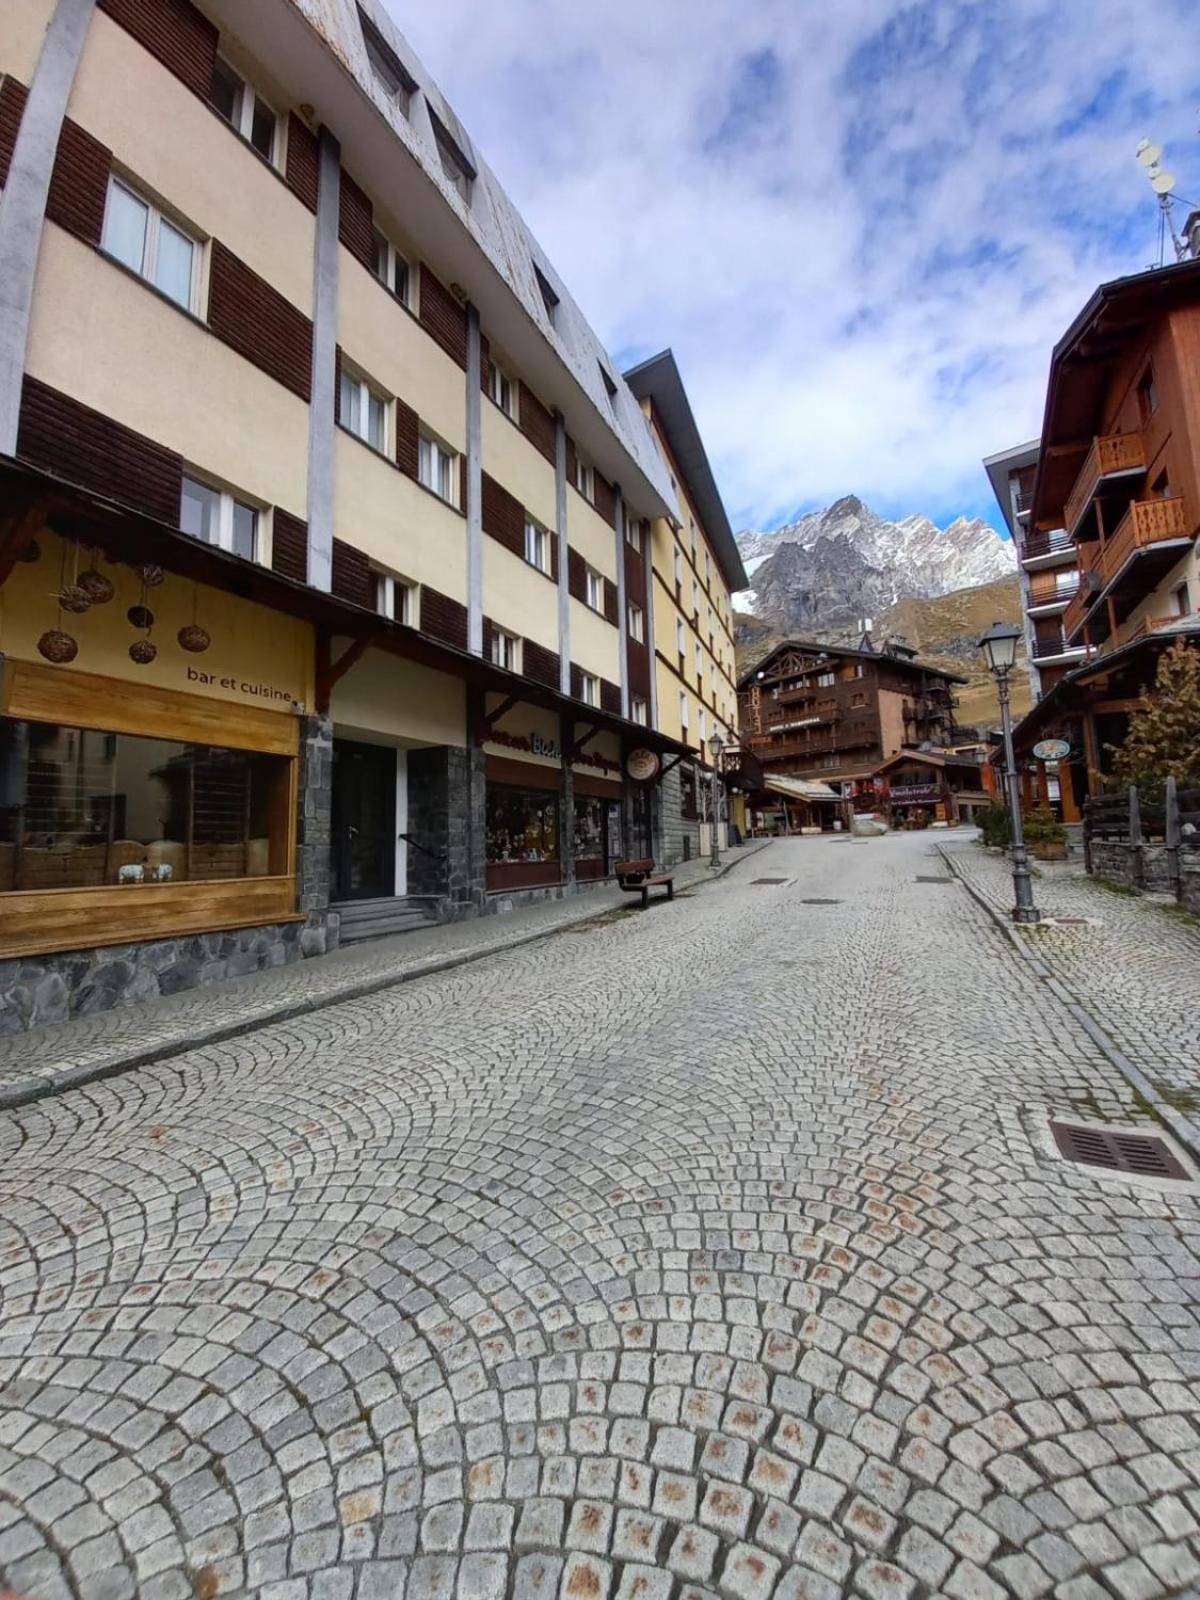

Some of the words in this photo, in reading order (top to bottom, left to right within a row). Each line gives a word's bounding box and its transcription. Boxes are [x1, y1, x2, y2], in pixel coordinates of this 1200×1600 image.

[187, 666, 216, 685] bar
[220, 677, 236, 690] et
[240, 681, 292, 702] cuisine
